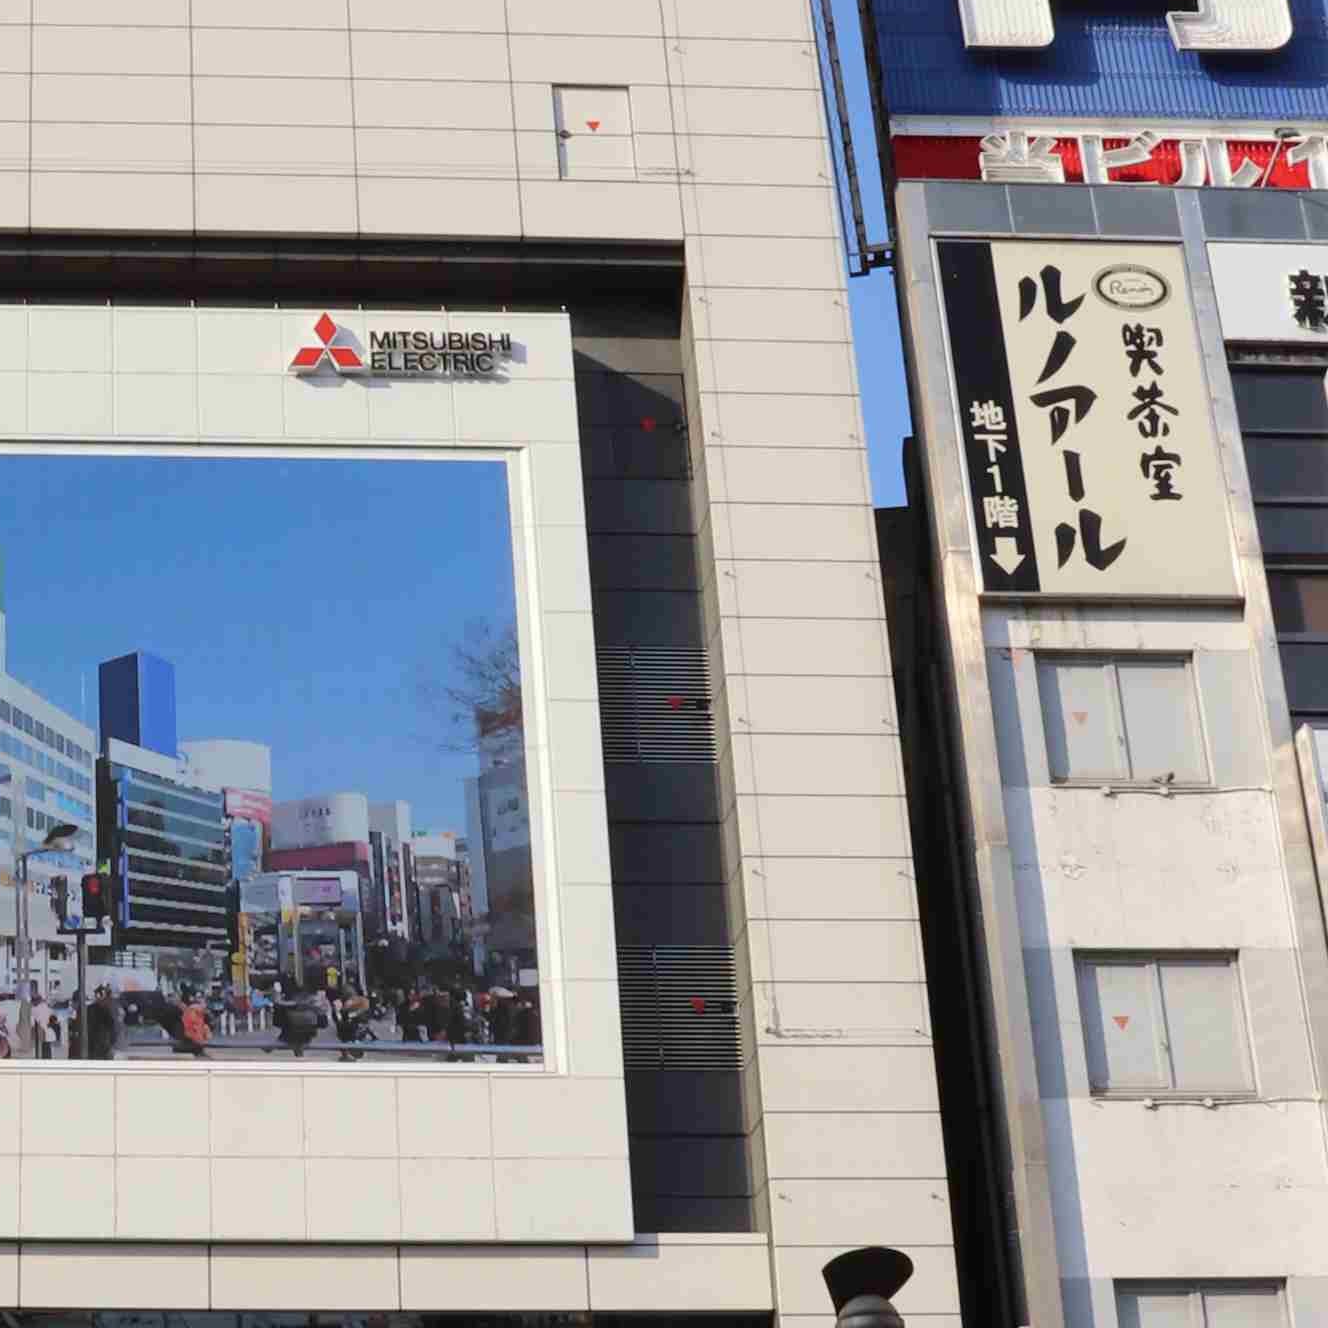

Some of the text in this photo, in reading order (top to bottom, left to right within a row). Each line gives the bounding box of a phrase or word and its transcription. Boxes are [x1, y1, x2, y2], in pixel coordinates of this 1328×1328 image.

[369, 330, 512, 353] MITSUBISHI
[370, 352, 495, 372] ELECTRIC
[969, 399, 1019, 529] 地下1階
[1017, 263, 1128, 572] ルノアール
[1121, 322, 1183, 501] 喫茶室
